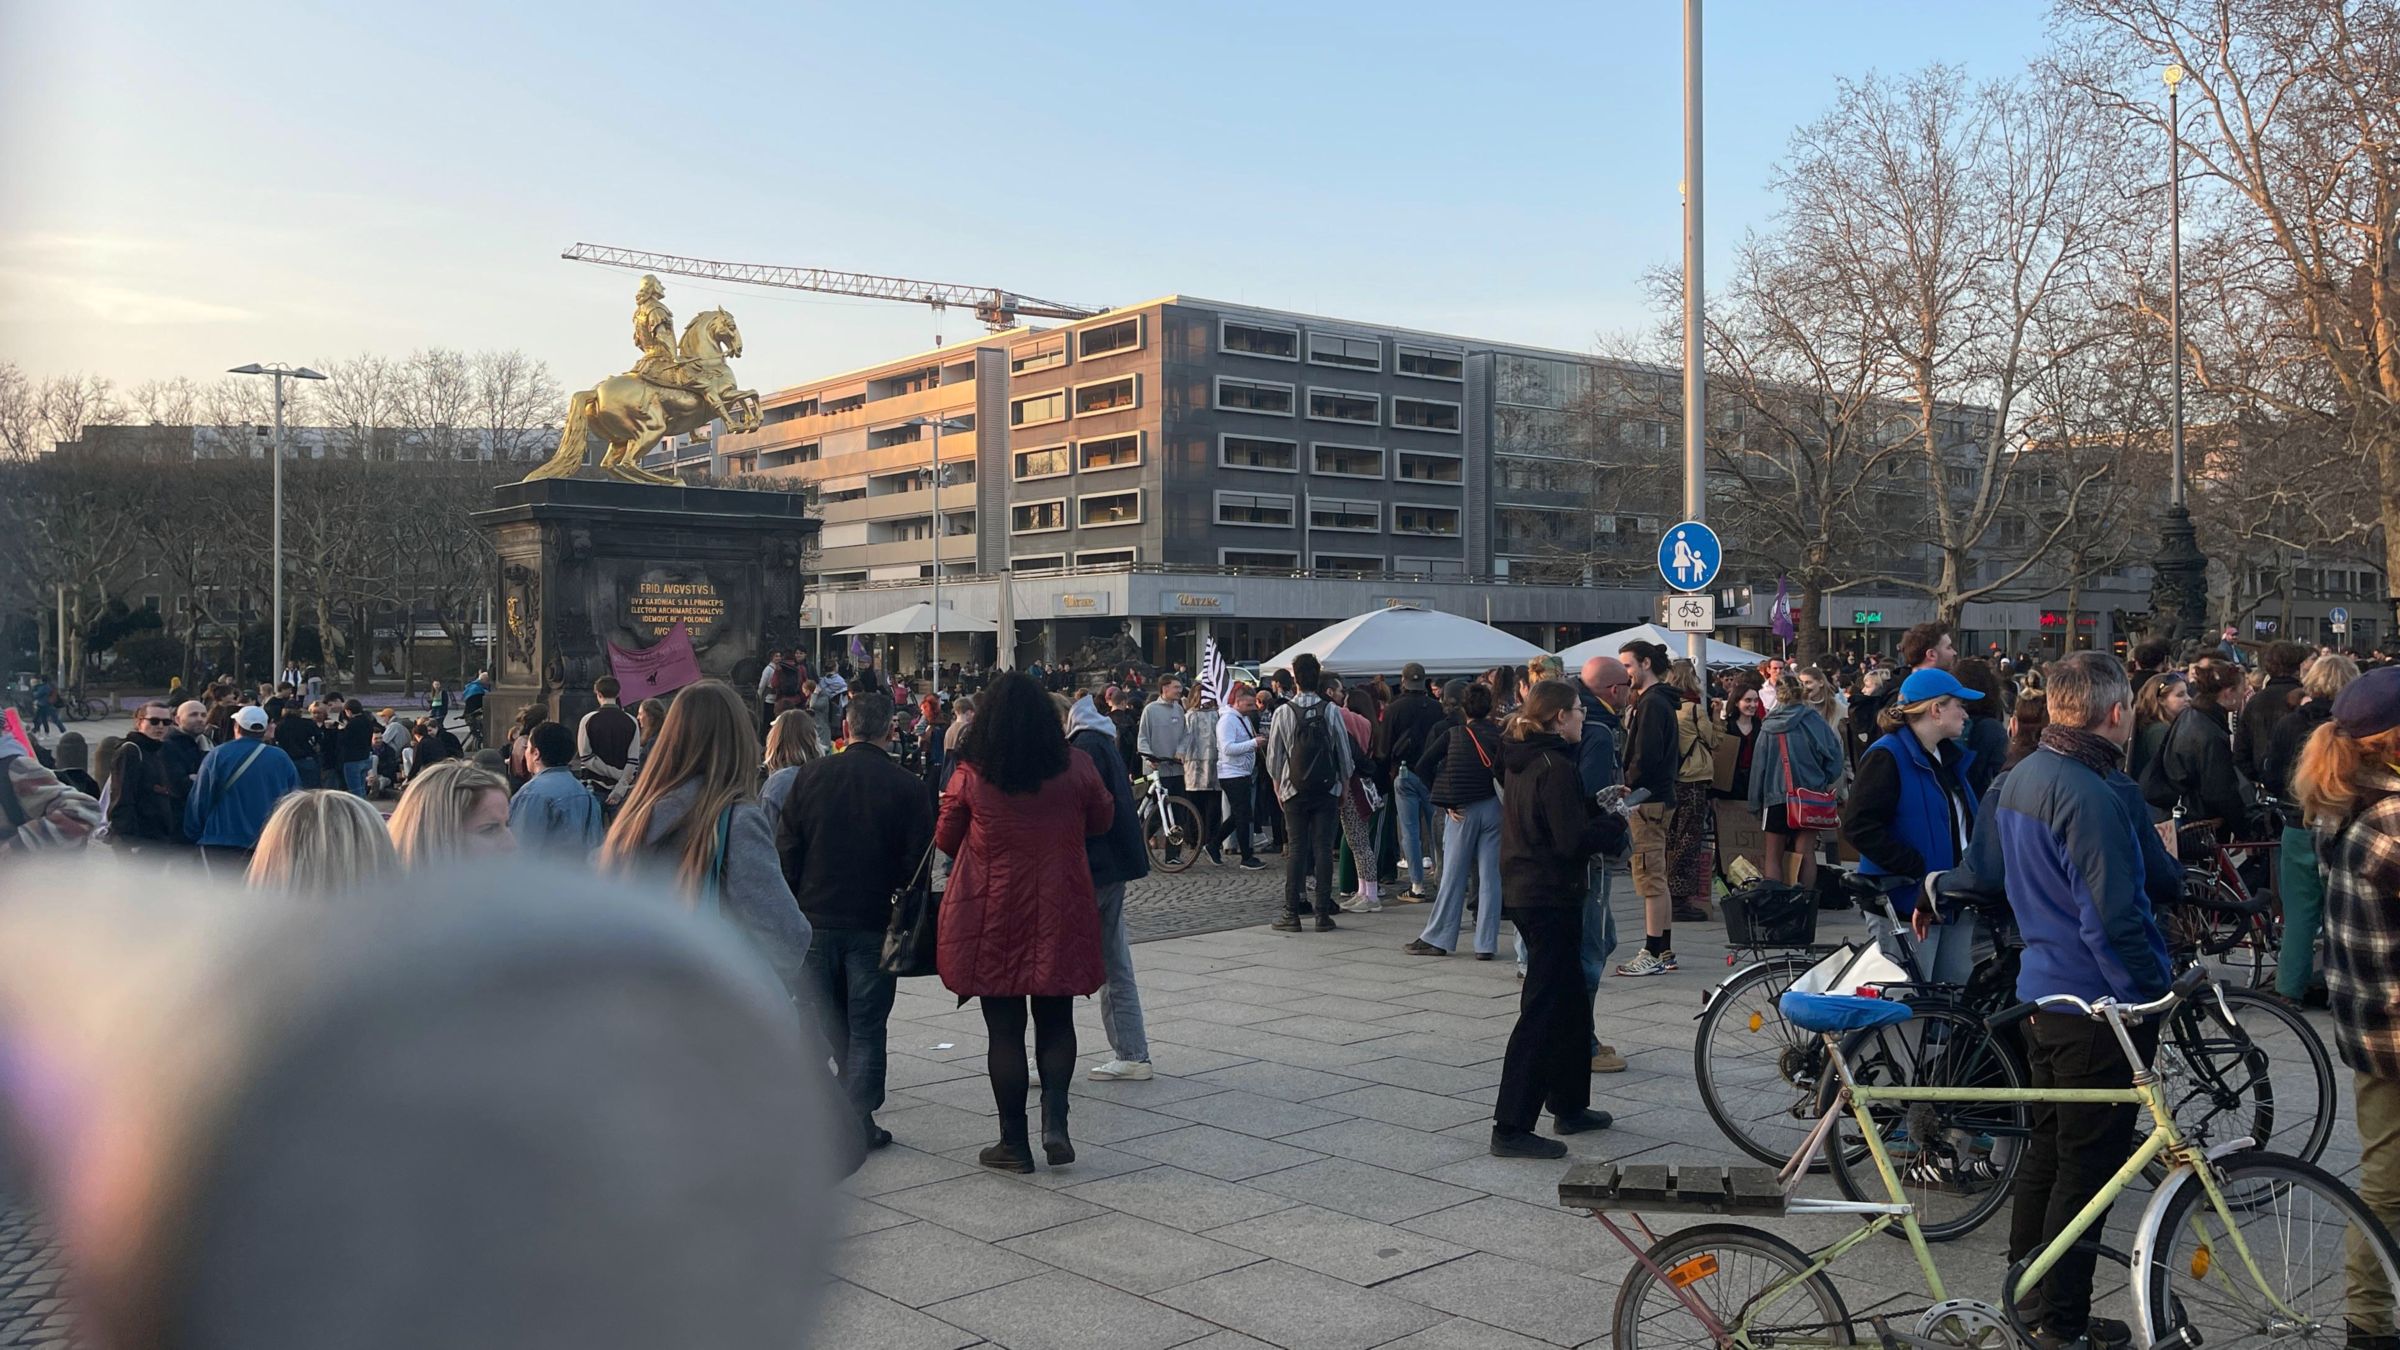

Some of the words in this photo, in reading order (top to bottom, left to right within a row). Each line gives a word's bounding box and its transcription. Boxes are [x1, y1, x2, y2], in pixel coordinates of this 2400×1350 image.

[663, 584, 709, 595] AVGVSTVS
[1684, 619, 1699, 627] frei
[1735, 831, 1759, 848] IST
